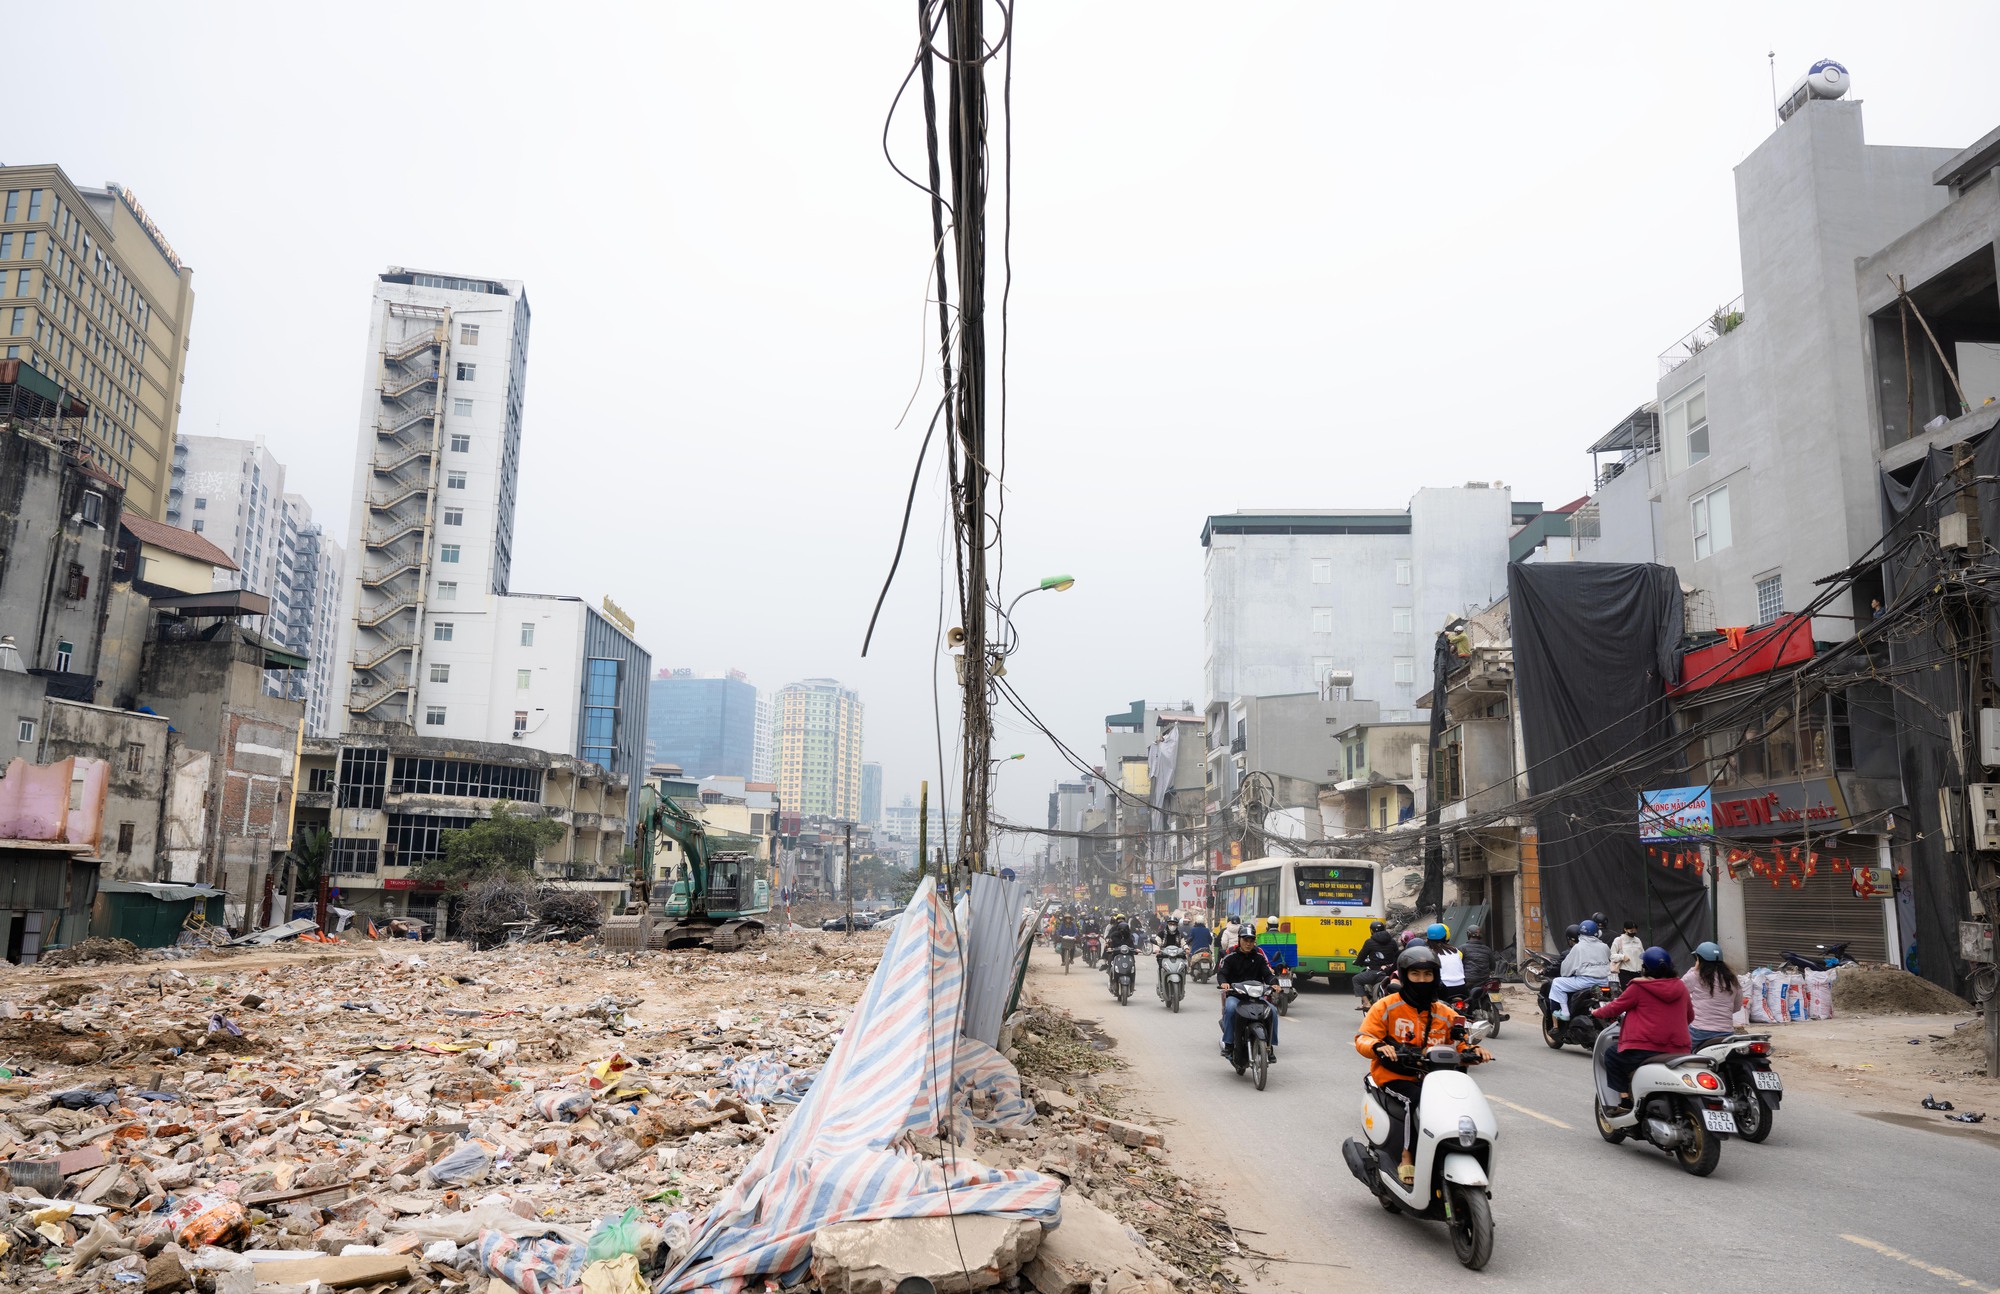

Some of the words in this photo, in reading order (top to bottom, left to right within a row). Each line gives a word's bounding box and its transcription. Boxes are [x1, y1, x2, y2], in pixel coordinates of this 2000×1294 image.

[673, 668, 692, 676] MSB
[1712, 797, 1772, 828] NEW
[1678, 817, 1685, 828] 7
[1329, 869, 1339, 878] 49
[1757, 1081, 1781, 1090] 876.40
[1708, 1121, 1734, 1131] 826.47
